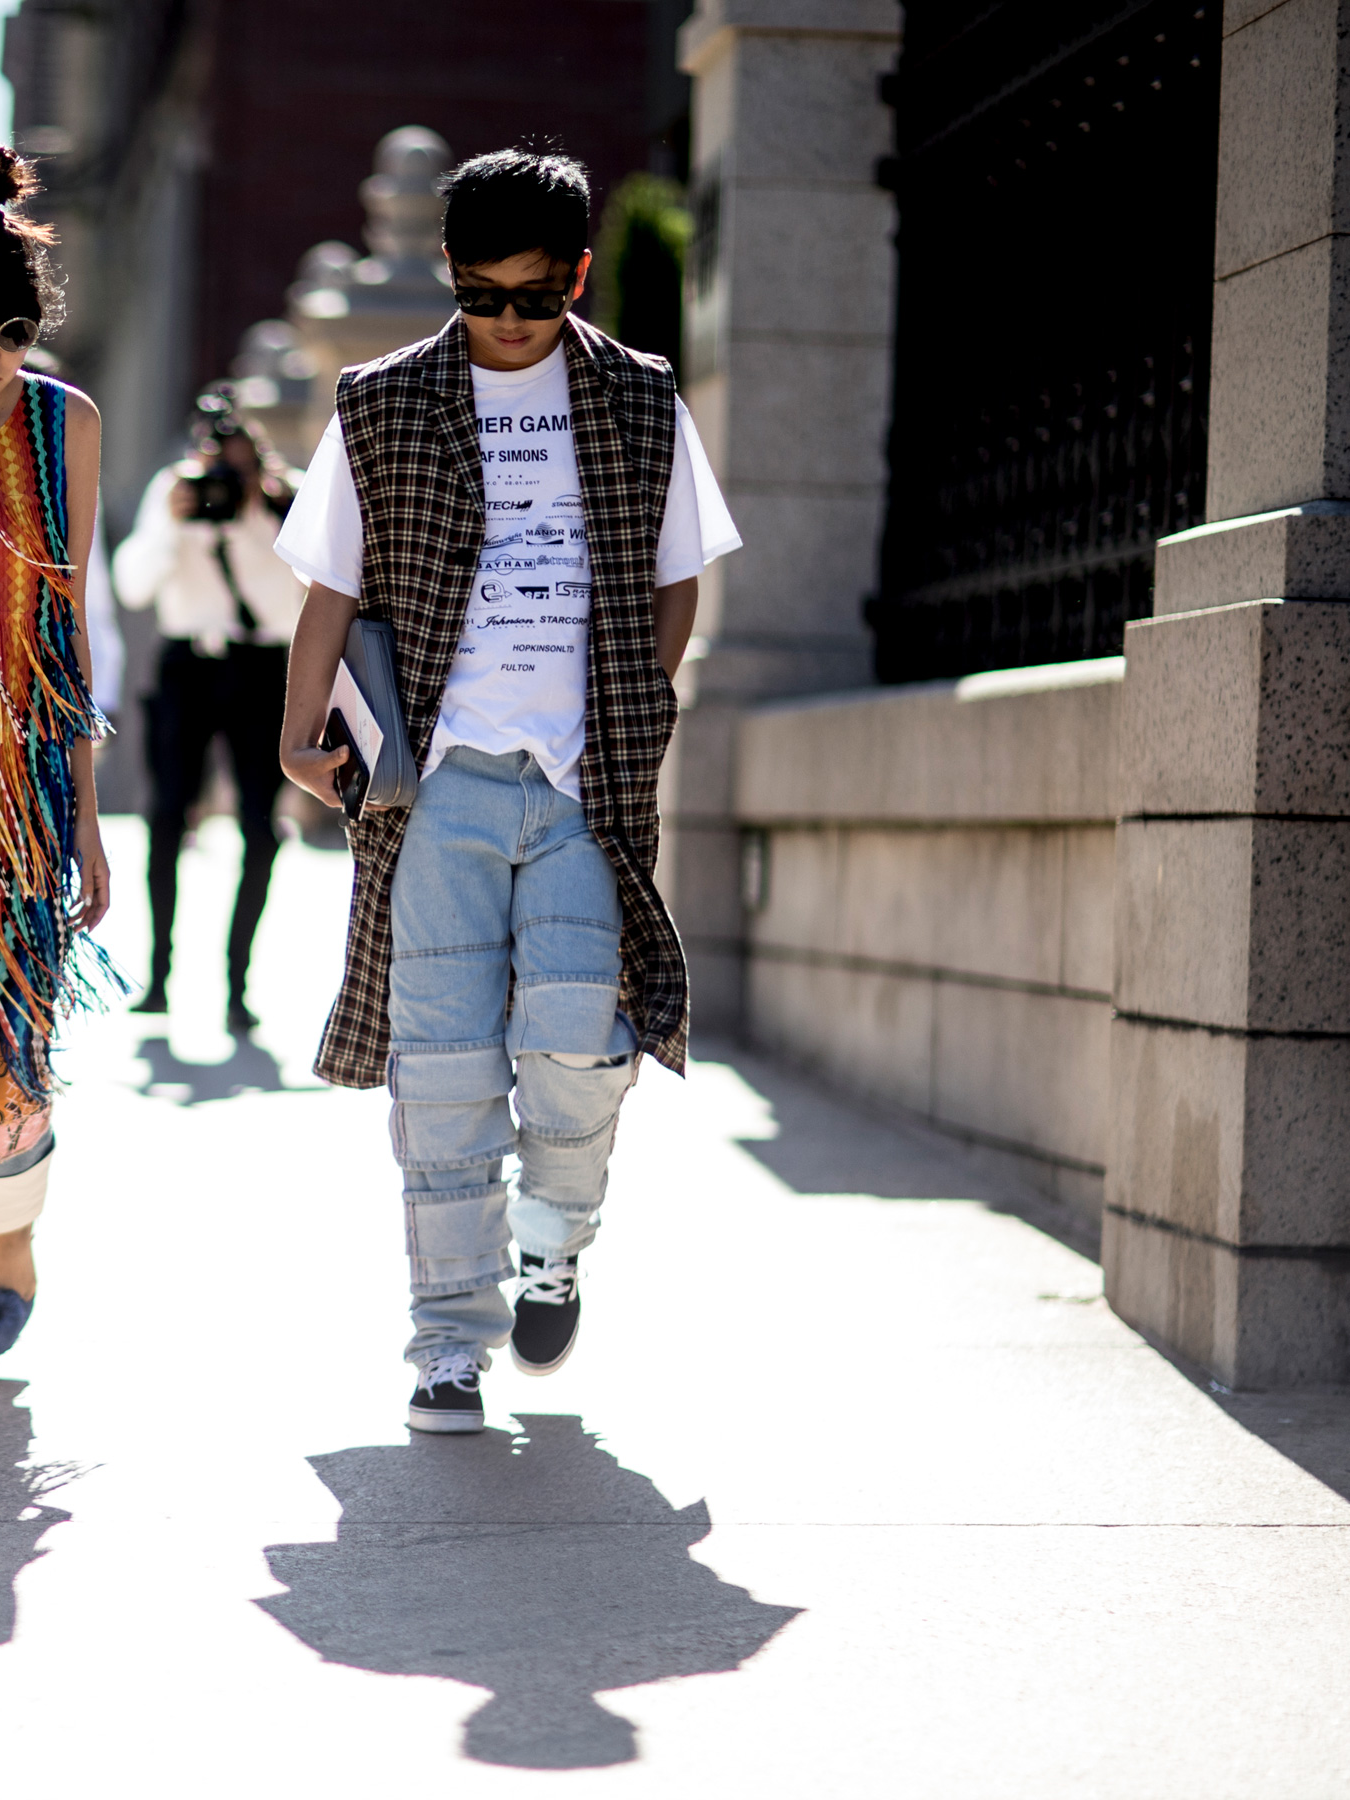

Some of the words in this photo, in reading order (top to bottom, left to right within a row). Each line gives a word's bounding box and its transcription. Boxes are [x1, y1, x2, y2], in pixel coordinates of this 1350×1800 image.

[520, 415, 572, 433] GAM
[499, 449, 548, 463] SIMONS
[485, 501, 520, 510] TECH
[526, 529, 565, 537] MANOR
[477, 614, 535, 629] Johnson
[458, 647, 476, 655] PPC
[500, 664, 536, 672] FULTON
